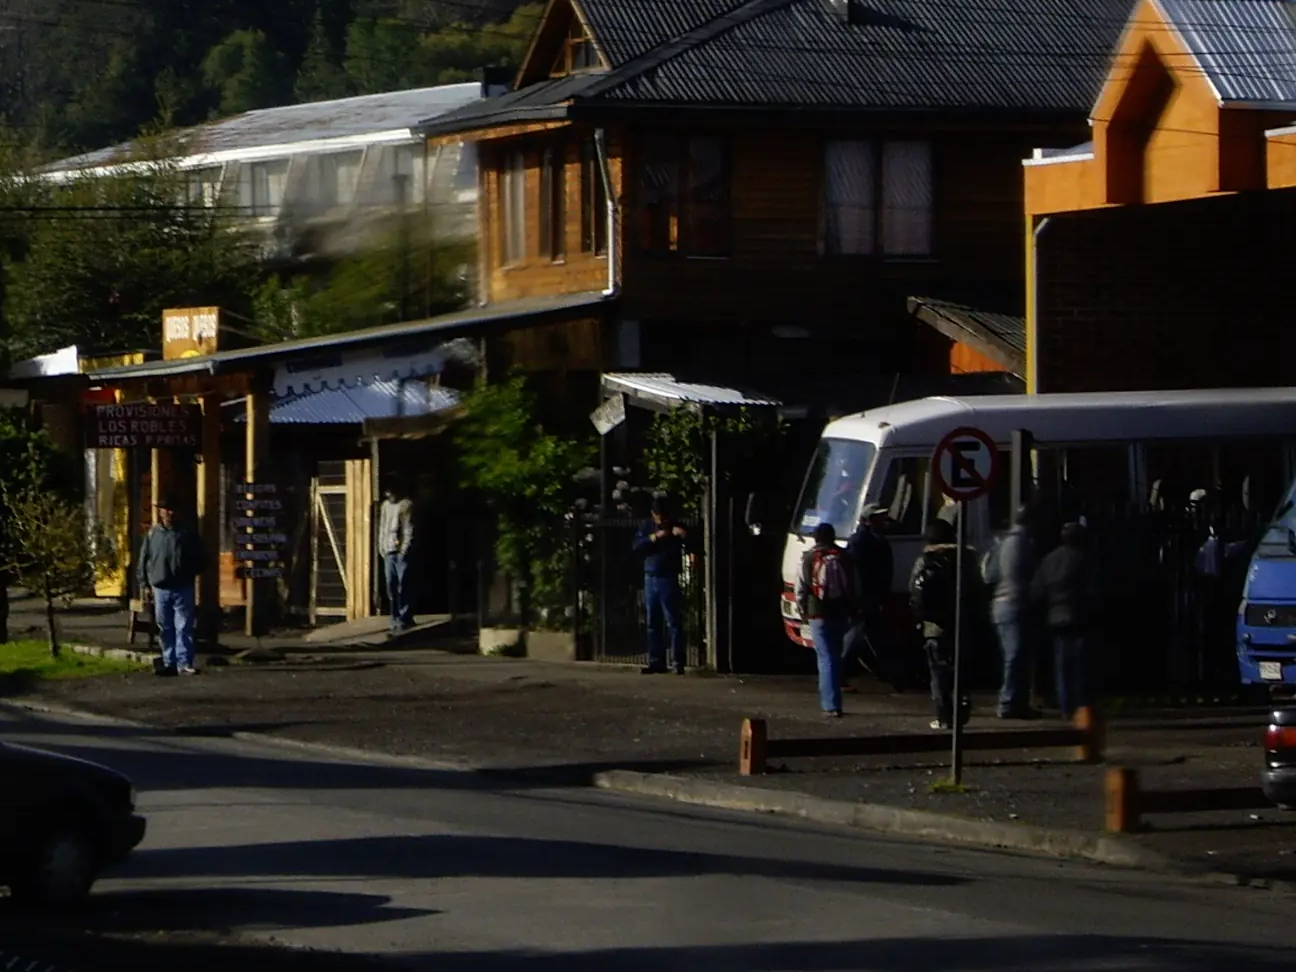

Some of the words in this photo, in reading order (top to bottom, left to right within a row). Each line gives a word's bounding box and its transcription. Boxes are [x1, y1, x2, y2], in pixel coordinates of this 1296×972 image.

[95, 404, 190, 418] PROVISIONES
[98, 419, 128, 433] LOS
[130, 419, 187, 433] ROBLES
[98, 434, 138, 446] RICAS
